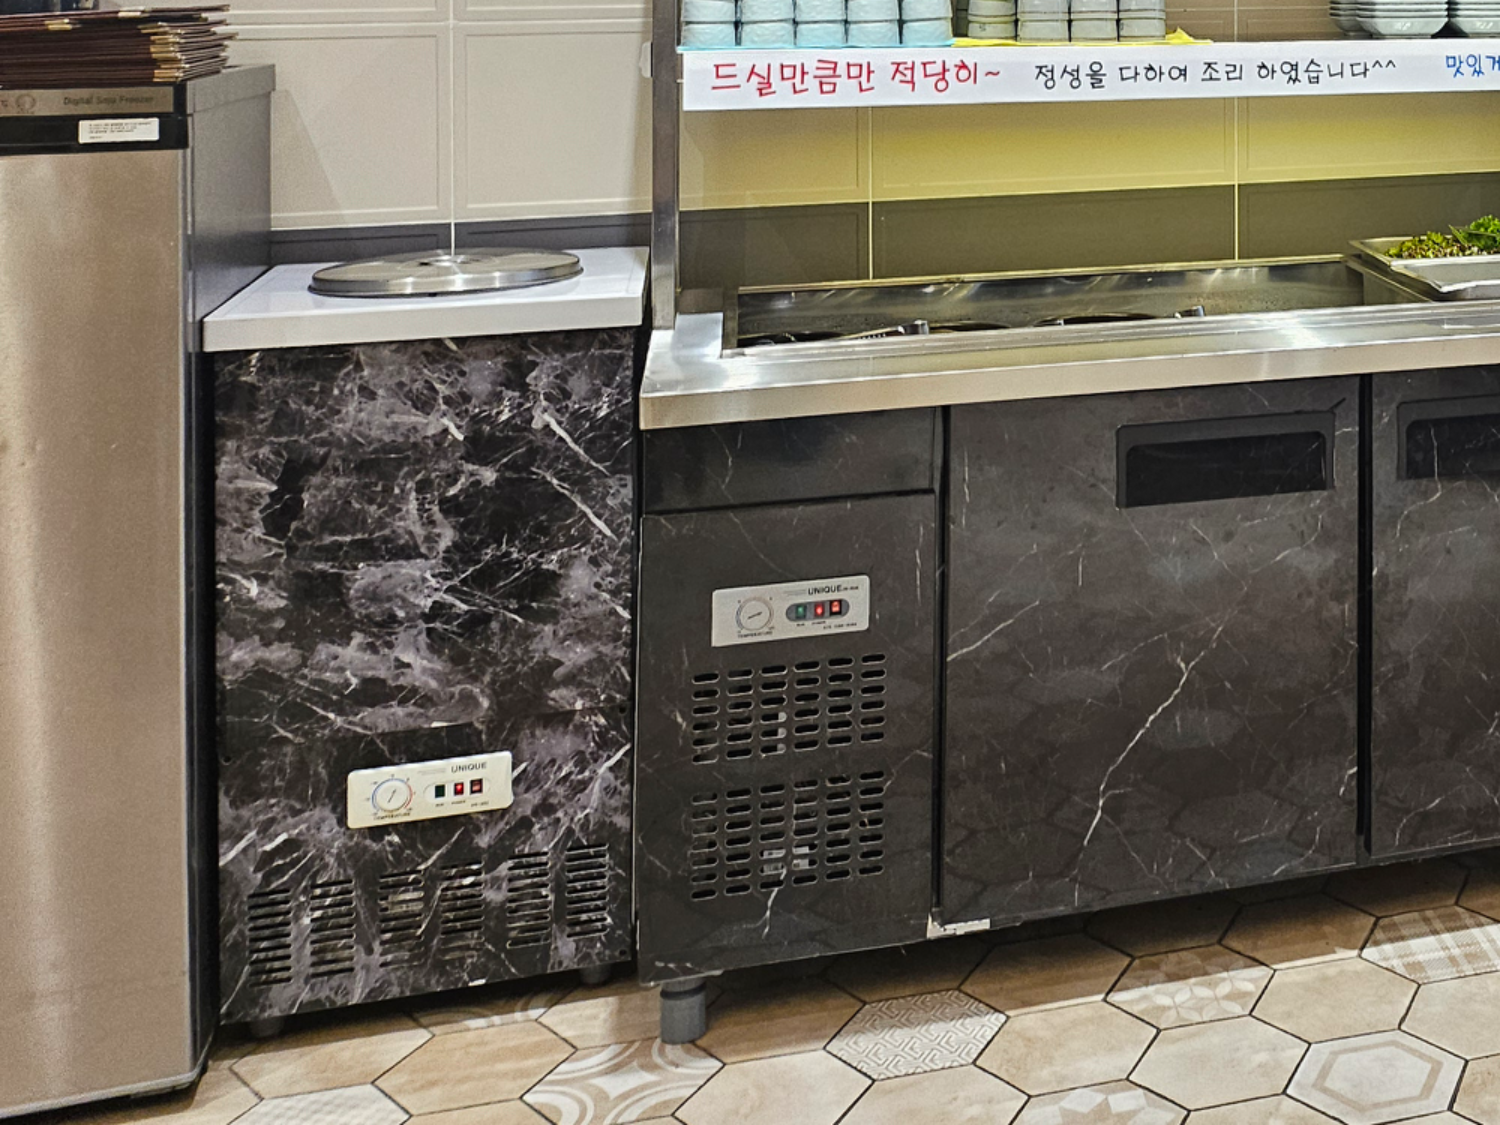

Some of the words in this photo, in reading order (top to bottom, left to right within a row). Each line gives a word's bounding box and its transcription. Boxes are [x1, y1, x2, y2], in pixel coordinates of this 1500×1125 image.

[711, 59, 875, 97] 드실만큼만
[890, 59, 1000, 93] 적당히~
[1034, 61, 1107, 90] 정성을
[1118, 62, 1188, 84] 다하여
[1201, 61, 1243, 82] 조리
[1256, 59, 1396, 85] 하였습니다^^
[63, 95, 93, 107] Digital
[119, 95, 154, 105] Freezer
[808, 584, 842, 596] UNIQUE
[451, 761, 488, 774] UNIQUE
